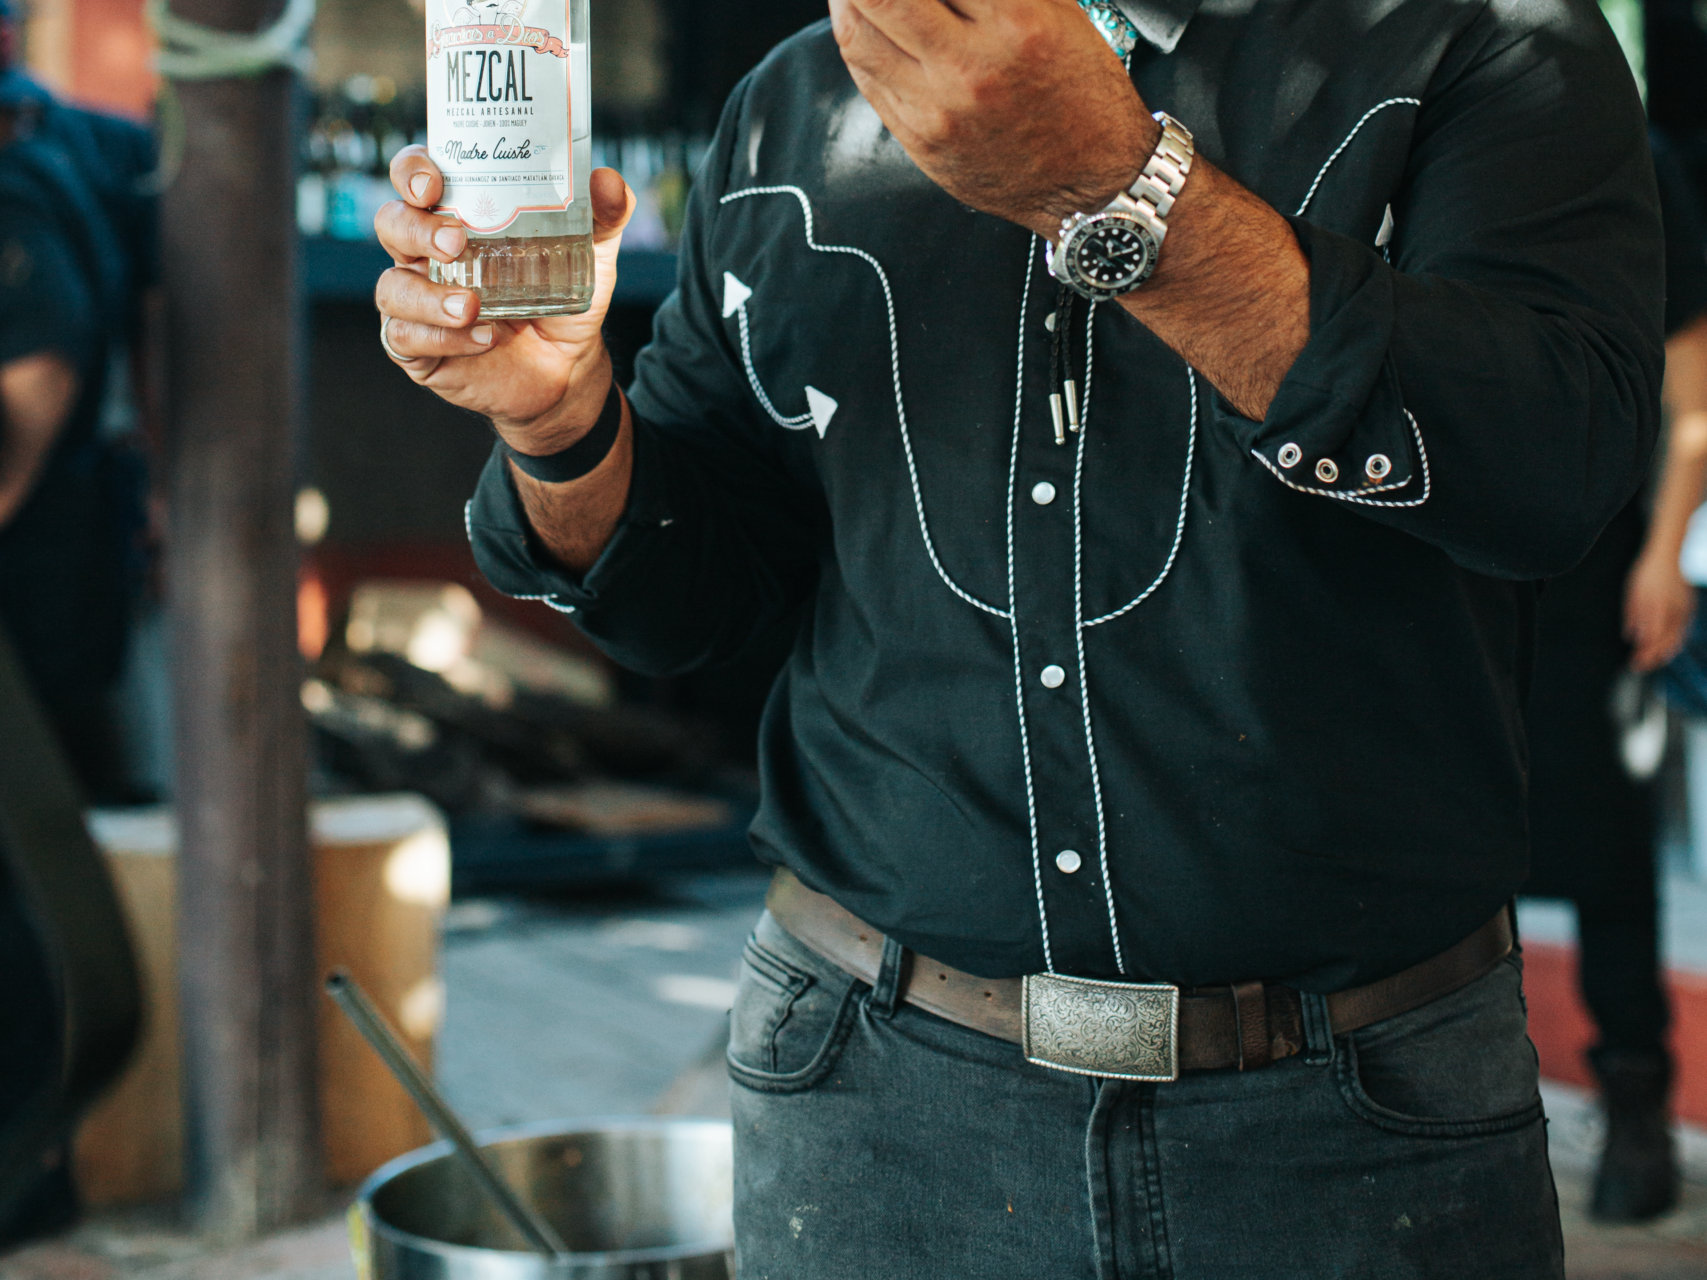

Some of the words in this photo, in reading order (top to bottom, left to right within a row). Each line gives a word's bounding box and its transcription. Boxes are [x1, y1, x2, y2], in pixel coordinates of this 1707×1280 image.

[431, 20, 483, 58] Gracias
[486, 30, 495, 39] a
[496, 14, 545, 46] Dios
[446, 50, 533, 102] MEZCAL
[446, 107, 475, 117] MEZCAL
[480, 106, 534, 116] ARTESANAL
[453, 120, 465, 128] MADRE
[465, 120, 479, 128] CUISHE
[482, 119, 496, 128] JOVEN
[499, 119, 510, 127] 100%
[510, 119, 527, 127] MAGUEY
[445, 140, 489, 164] Madre
[492, 136, 532, 160] Cuishe
